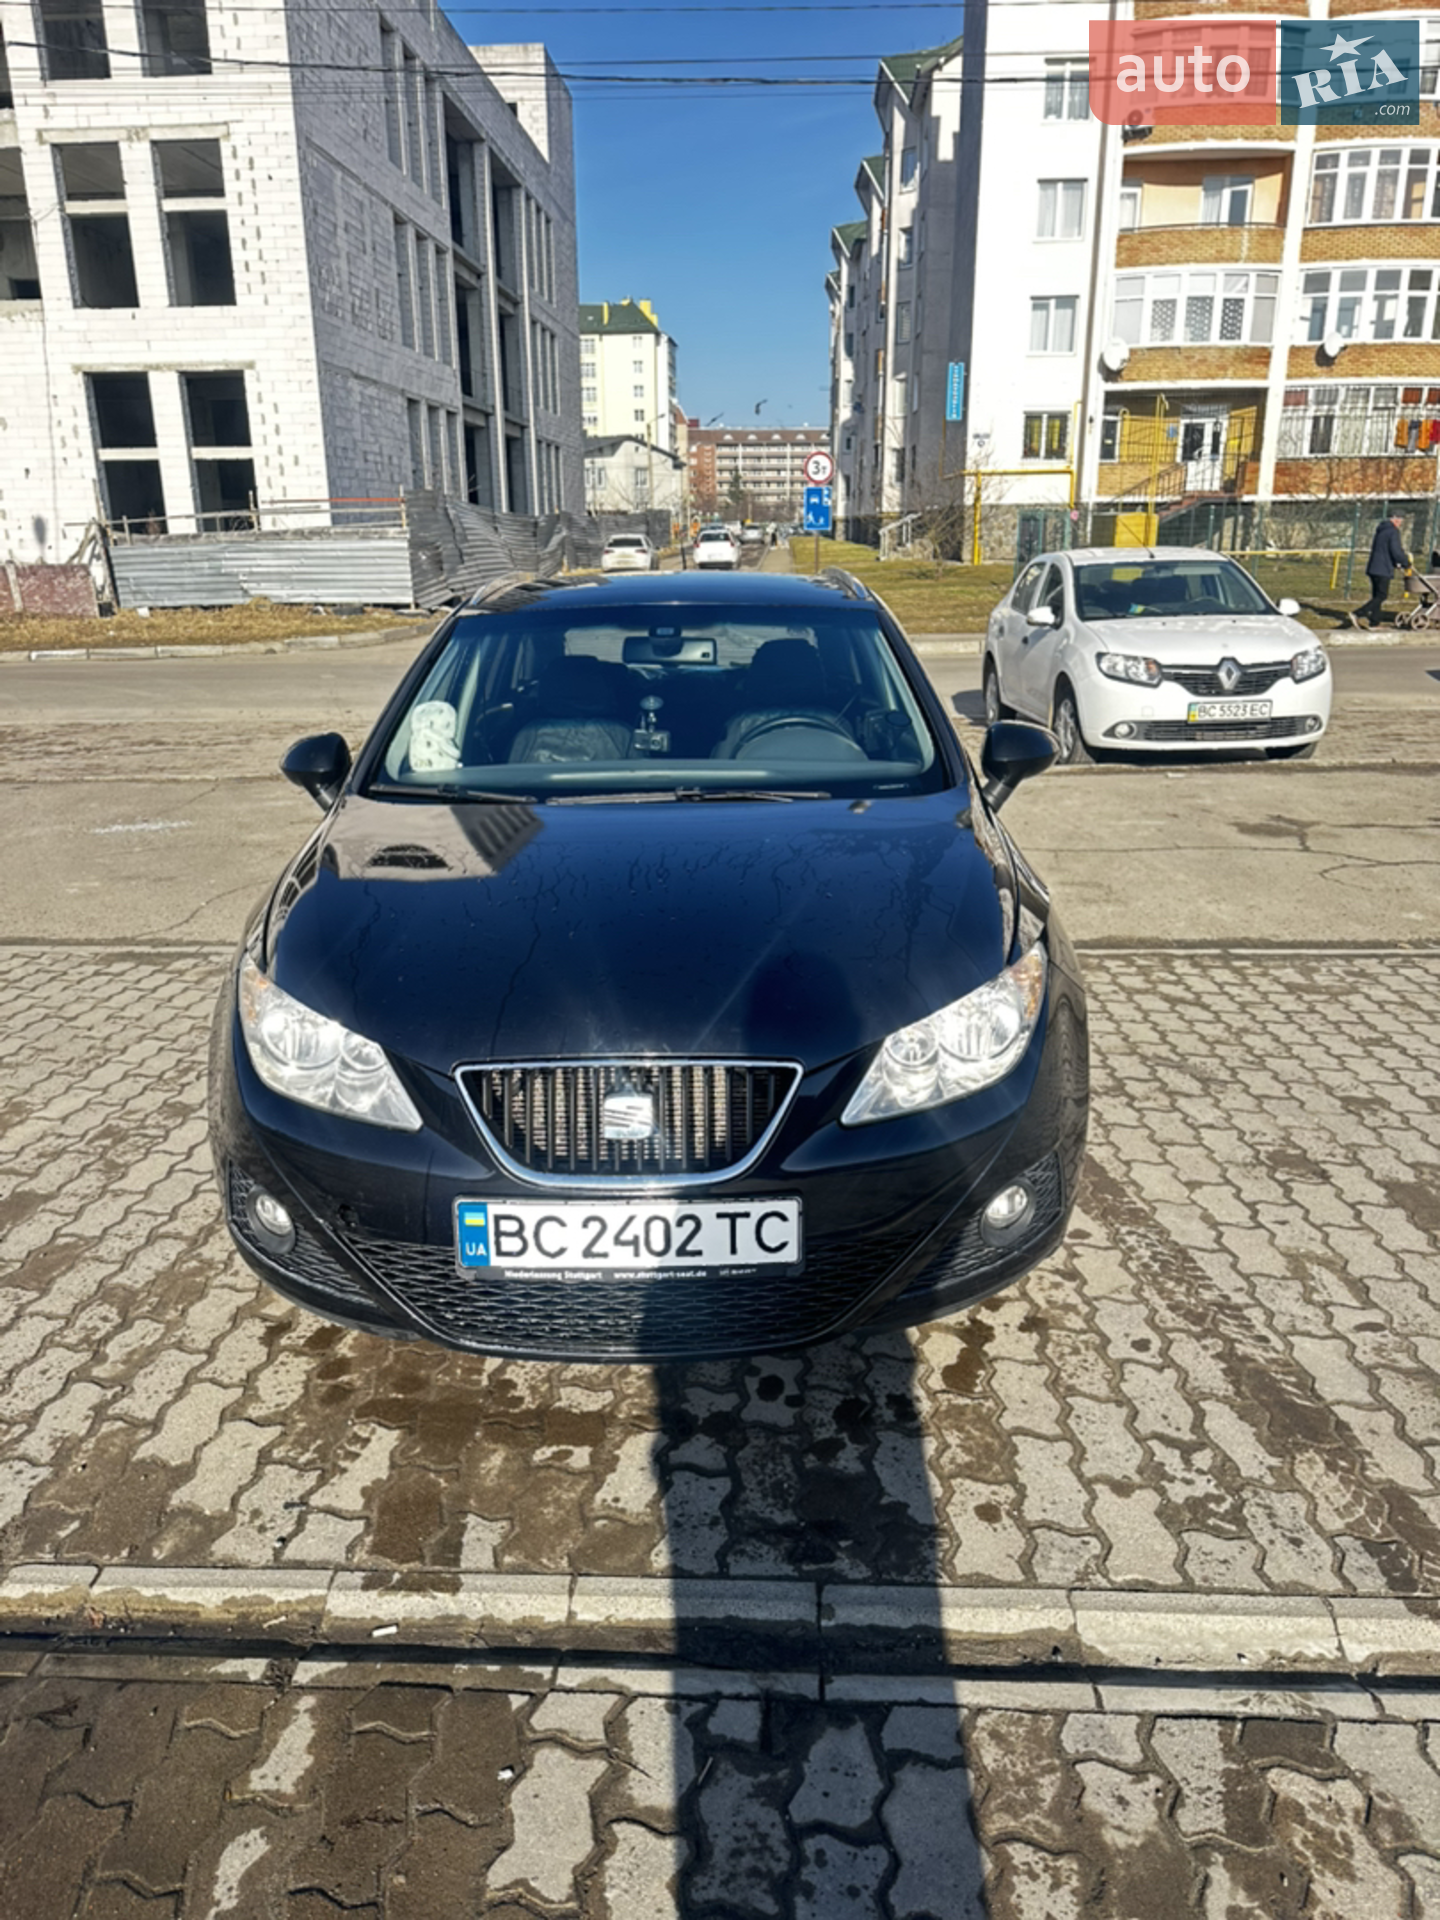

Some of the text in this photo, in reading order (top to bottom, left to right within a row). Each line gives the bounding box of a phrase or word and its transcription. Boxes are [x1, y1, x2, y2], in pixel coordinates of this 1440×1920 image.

[1198, 704, 1268, 718] BC 5523 EC
[493, 1211, 790, 1259] BC 2402 TC
[465, 1242, 487, 1257] UA
[564, 1270, 603, 1279] Stuttgart
